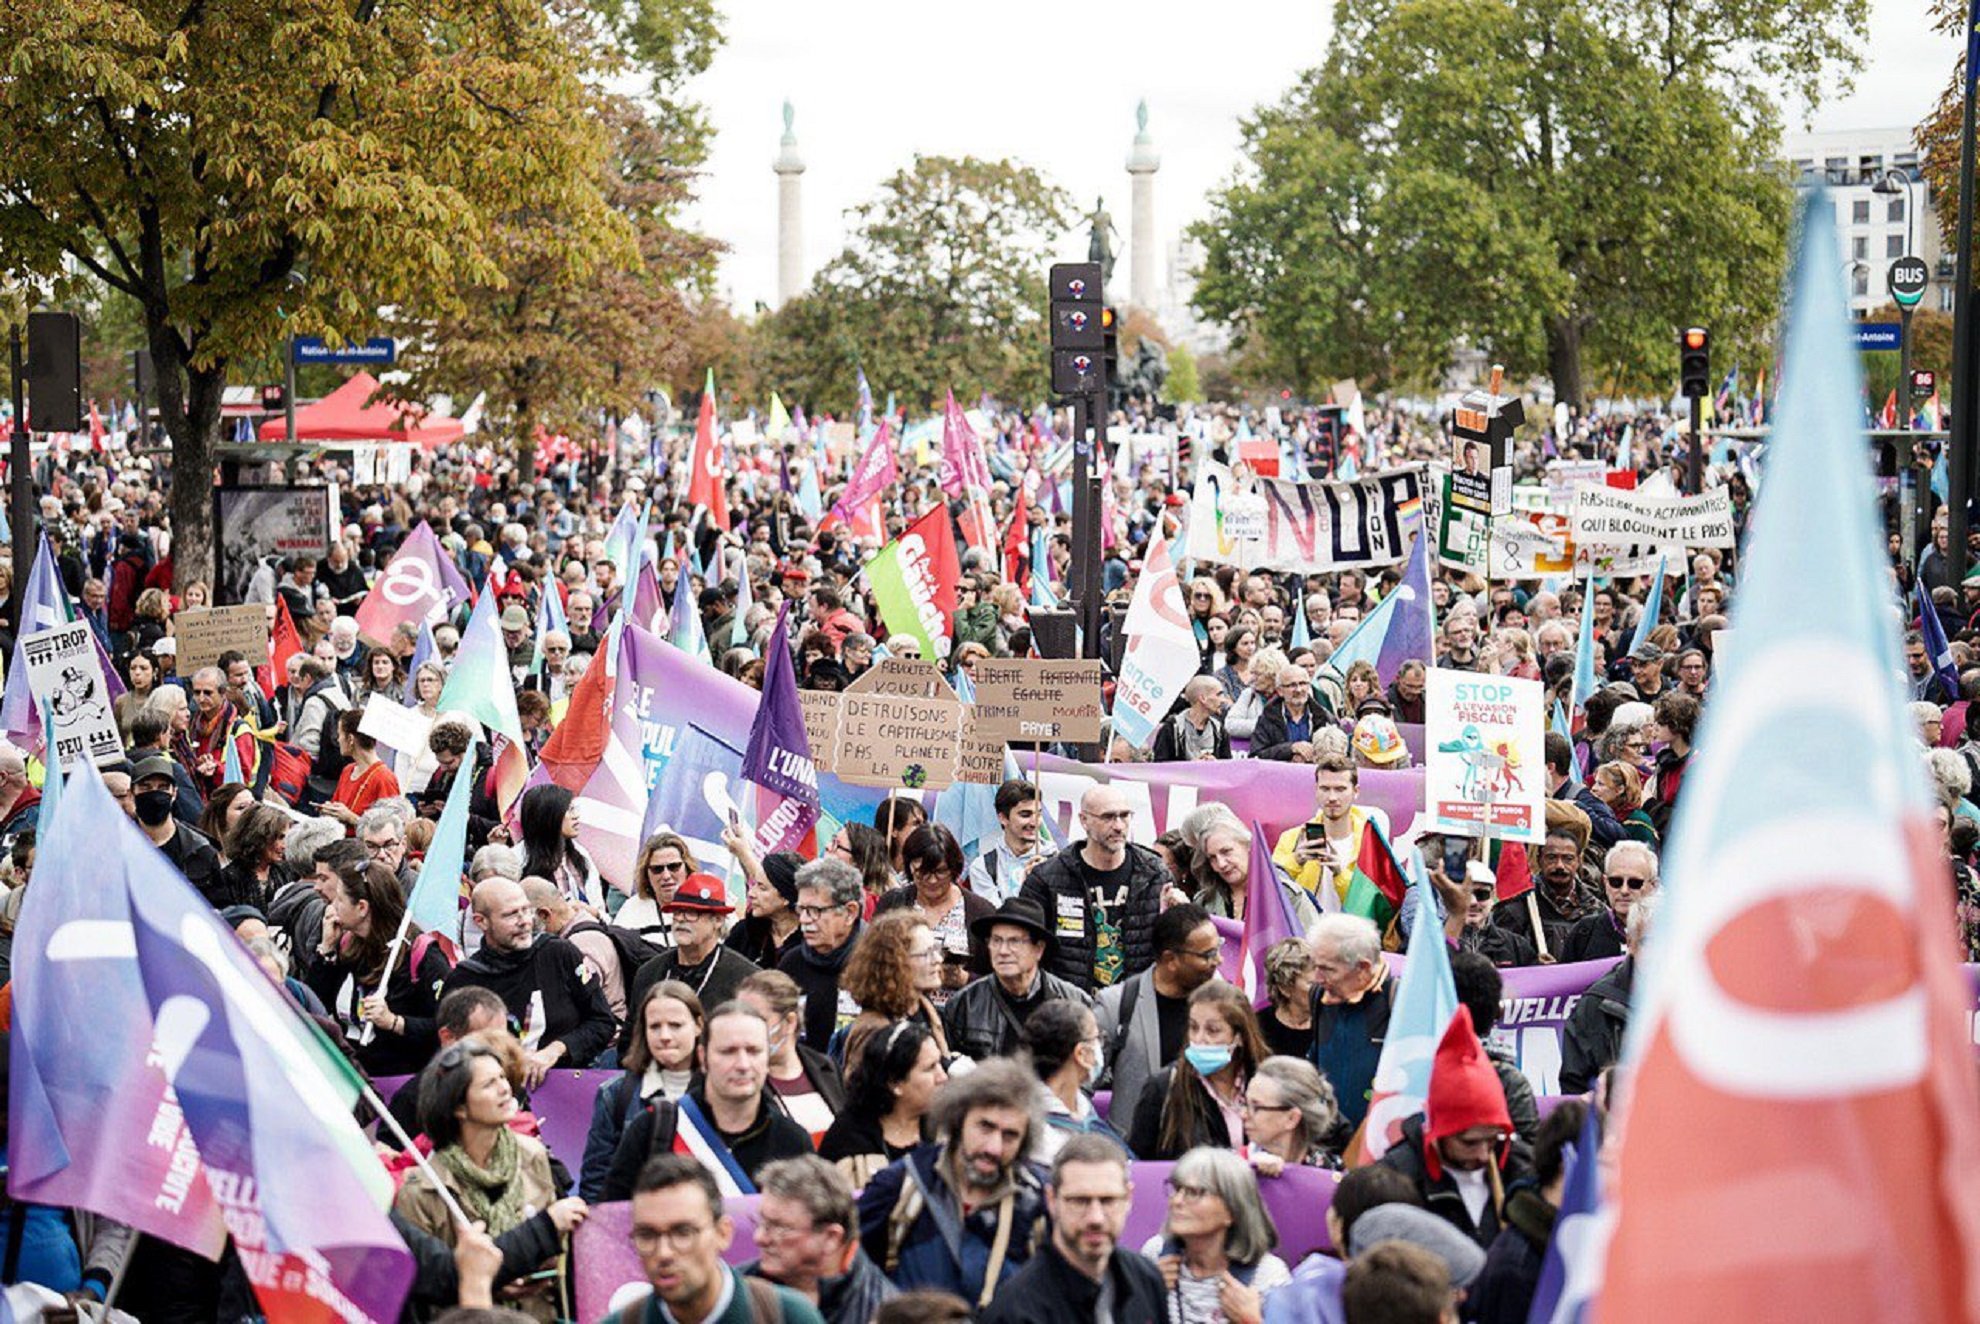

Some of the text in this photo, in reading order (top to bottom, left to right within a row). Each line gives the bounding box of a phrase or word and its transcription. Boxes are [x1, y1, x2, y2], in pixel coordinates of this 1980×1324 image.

[1895, 268, 1924, 283] BUS
[1915, 373, 1932, 385] 86
[1581, 517, 1607, 532] QUI
[1682, 527, 1696, 540] LE
[52, 629, 88, 651] TROP
[875, 681, 919, 694] VOUS
[1455, 683, 1513, 702] STOP
[976, 704, 1098, 718] TRIMER MOURIR
[1458, 711, 1514, 725] FISCALE
[846, 723, 866, 736] LE
[878, 724, 958, 742] CAPITALISME
[1020, 721, 1062, 737] PAYER
[56, 736, 83, 757] PEU
[844, 742, 872, 760] PAS
[872, 762, 889, 775] LA
[961, 755, 1003, 771] NOTRE
